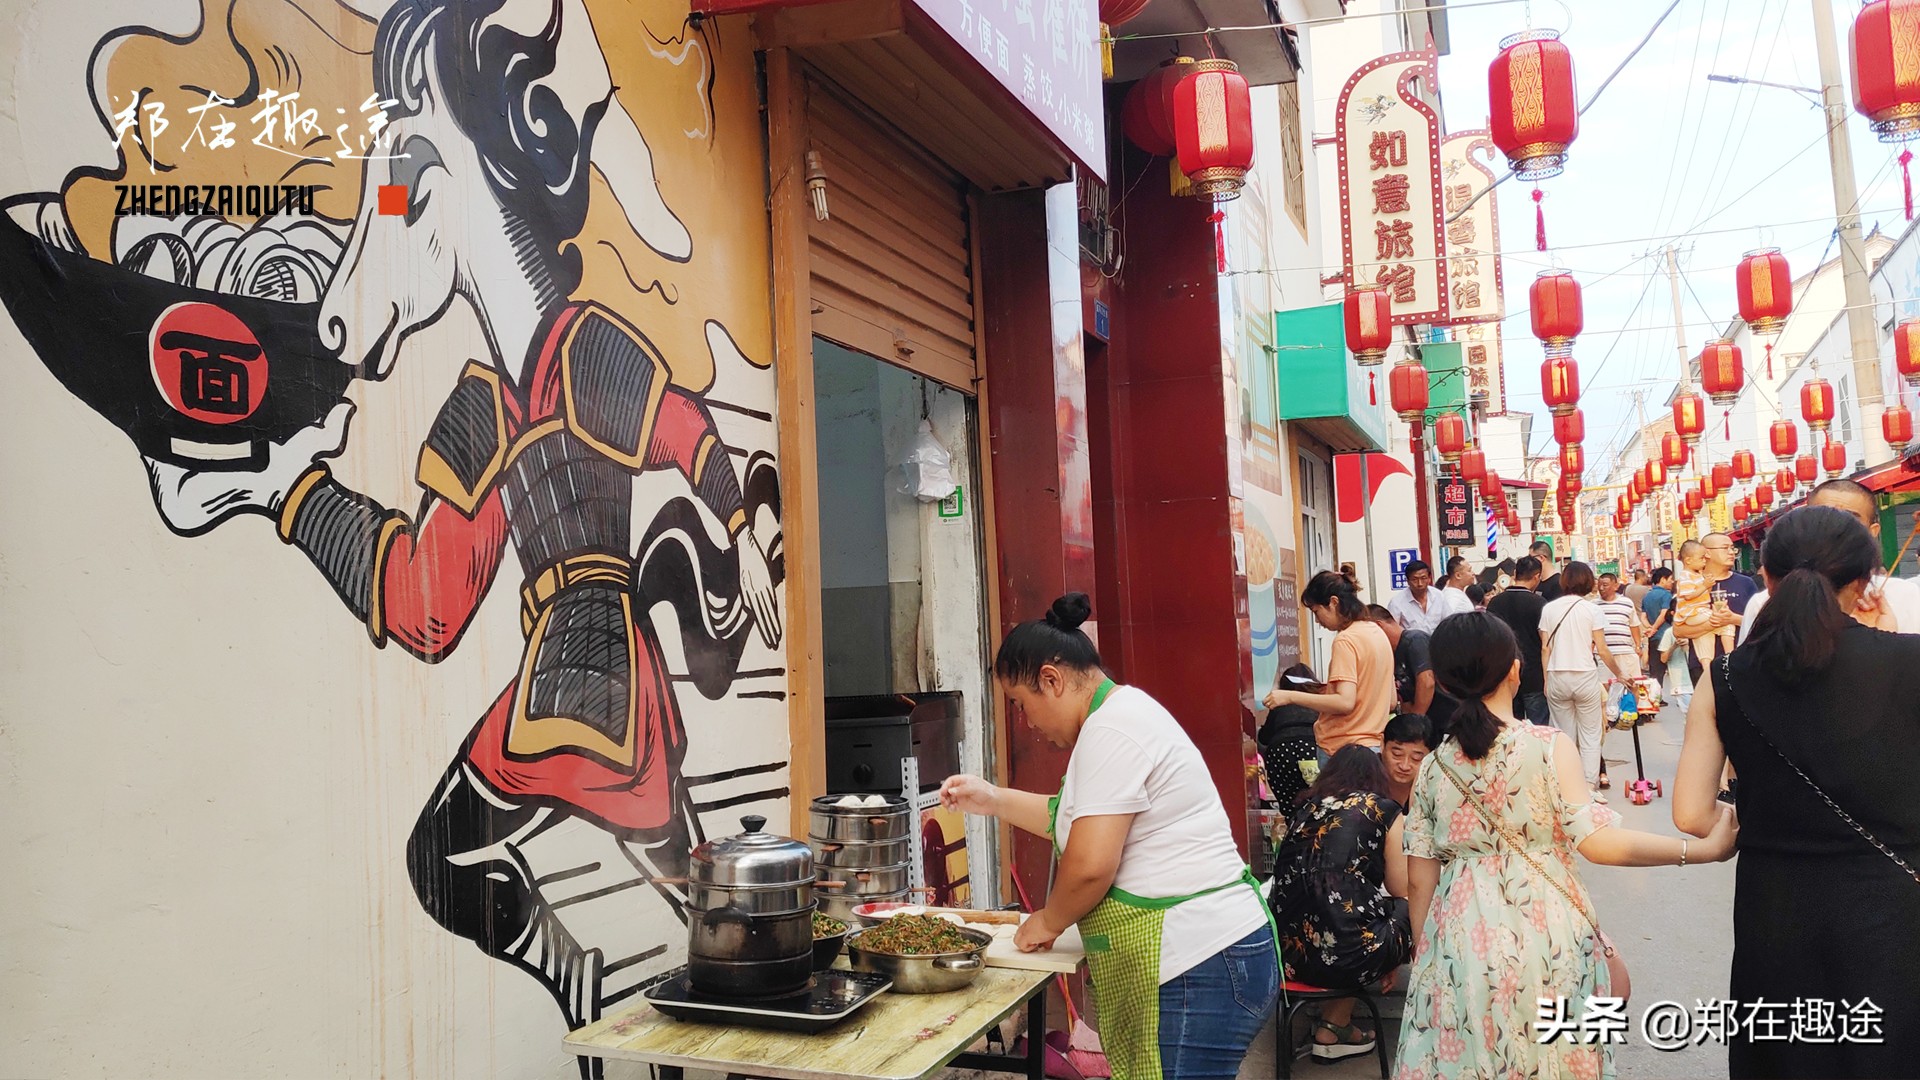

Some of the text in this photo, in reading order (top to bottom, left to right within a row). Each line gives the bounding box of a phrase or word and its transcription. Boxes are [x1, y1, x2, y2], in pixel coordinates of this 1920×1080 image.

[1368, 130, 1416, 304] 如意旅馆
[160, 330, 262, 414] 面
[1444, 484, 1467, 527] 超市
[1395, 551, 1411, 572] P
